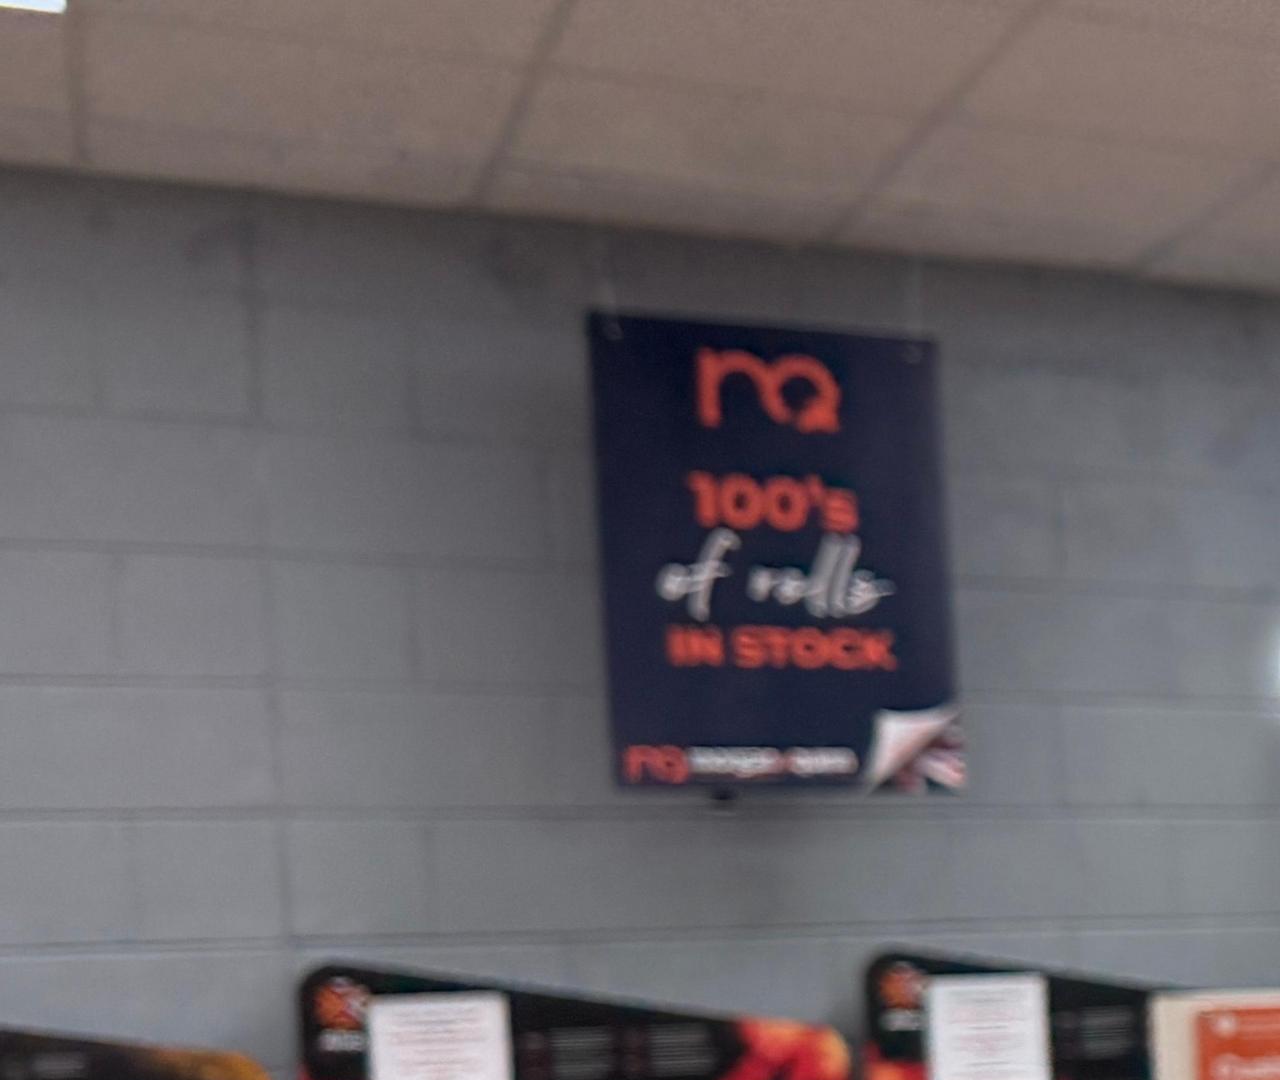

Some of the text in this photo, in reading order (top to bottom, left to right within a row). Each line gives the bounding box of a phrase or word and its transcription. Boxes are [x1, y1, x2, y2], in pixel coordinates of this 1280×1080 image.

[688, 473, 860, 532] 100's
[655, 527, 742, 622] of
[666, 627, 898, 671] IN STOCK
